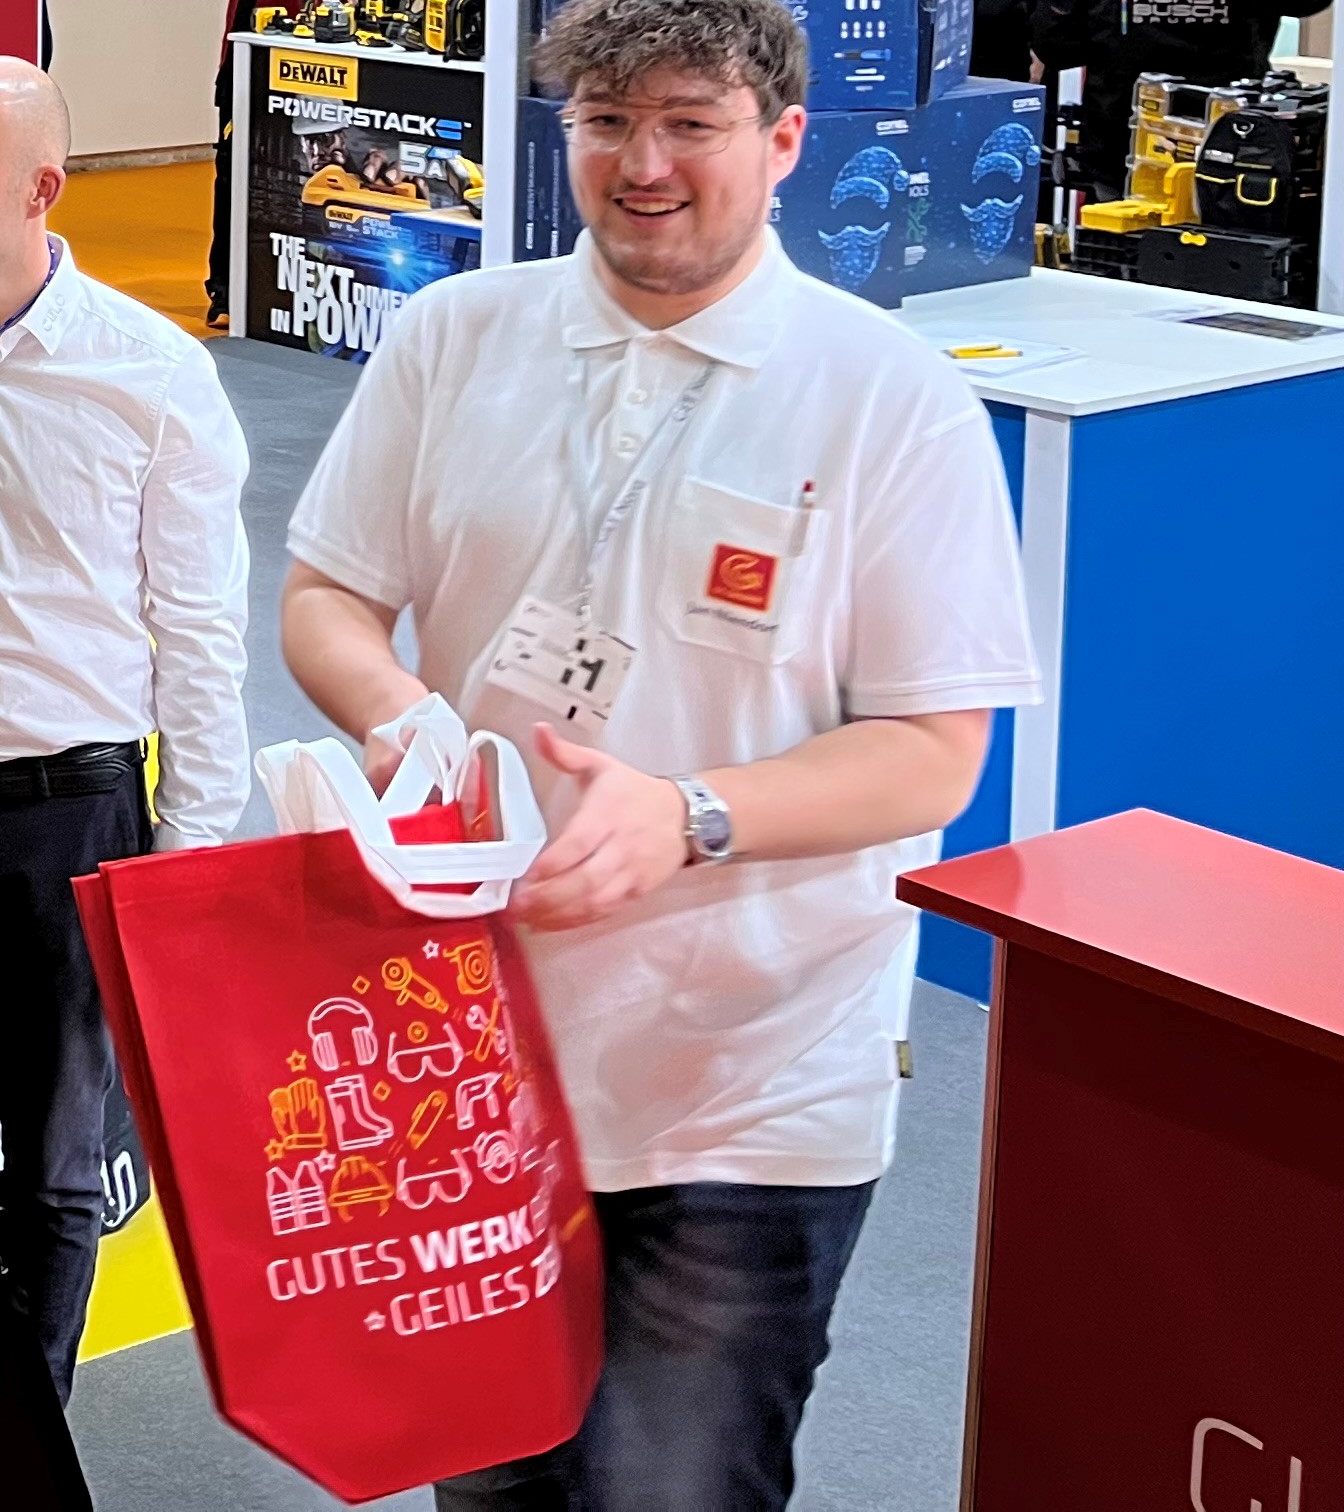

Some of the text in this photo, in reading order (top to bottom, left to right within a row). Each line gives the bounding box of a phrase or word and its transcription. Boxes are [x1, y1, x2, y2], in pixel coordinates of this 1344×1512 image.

[1133, 3, 1229, 17] BUSCH
[268, 95, 437, 138] POWERSTACK
[269, 232, 306, 258] THE
[278, 255, 410, 312] NEXT DIME
[270, 307, 291, 334] IN
[266, 1238, 407, 1302] GUTES
[409, 1204, 534, 1274] WERK
[389, 1265, 531, 1336] GEILES
